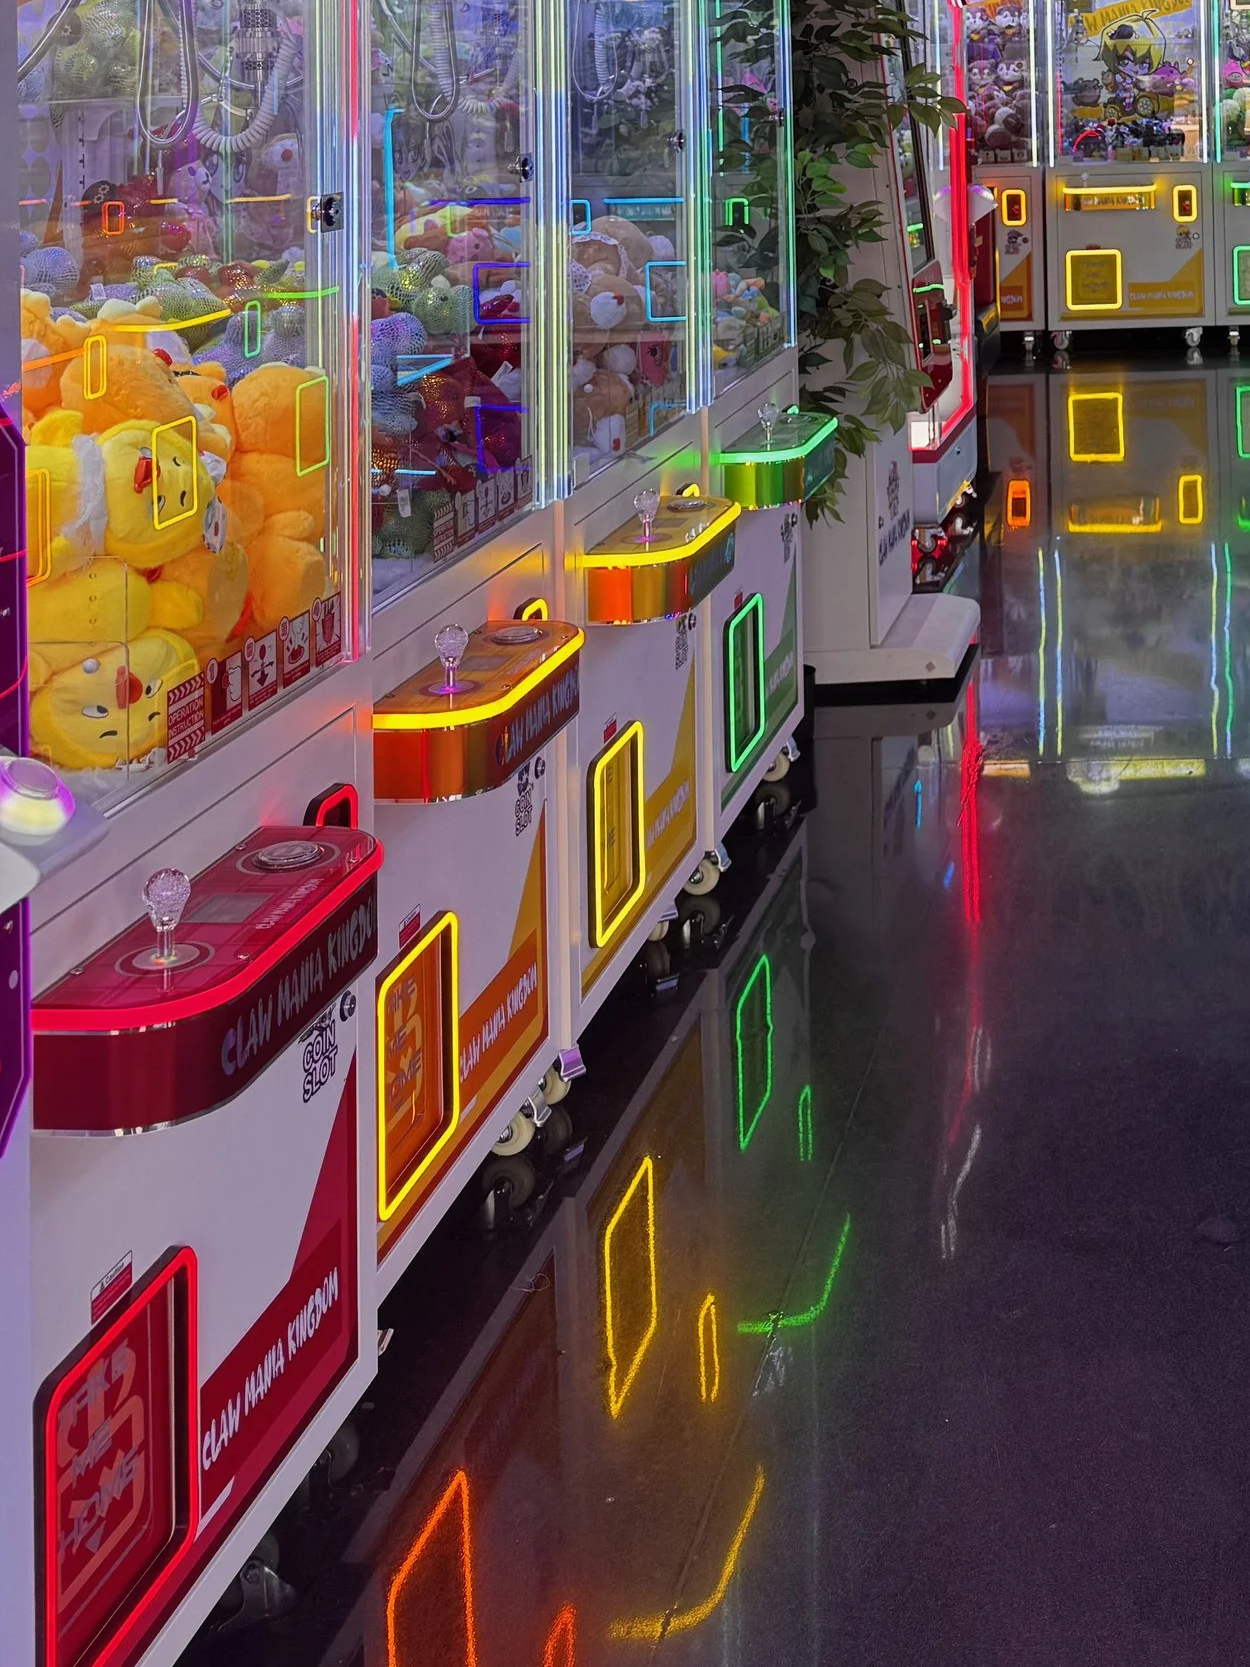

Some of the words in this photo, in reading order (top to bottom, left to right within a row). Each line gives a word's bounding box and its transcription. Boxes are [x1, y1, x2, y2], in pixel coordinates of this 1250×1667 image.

[168, 696, 204, 727] OPERATION
[220, 993, 274, 1076] CLAW
[276, 948, 324, 1028] MANIA
[327, 894, 378, 980] KINGDO
[482, 1004, 506, 1054] MANIA
[506, 962, 538, 1025] KINGDOM
[302, 1019, 337, 1074] COIN
[302, 1048, 338, 1104] SLOT
[202, 1391, 241, 1471] CLAW
[244, 1337, 285, 1417] MANIA
[287, 1266, 339, 1362] KINGDOM
